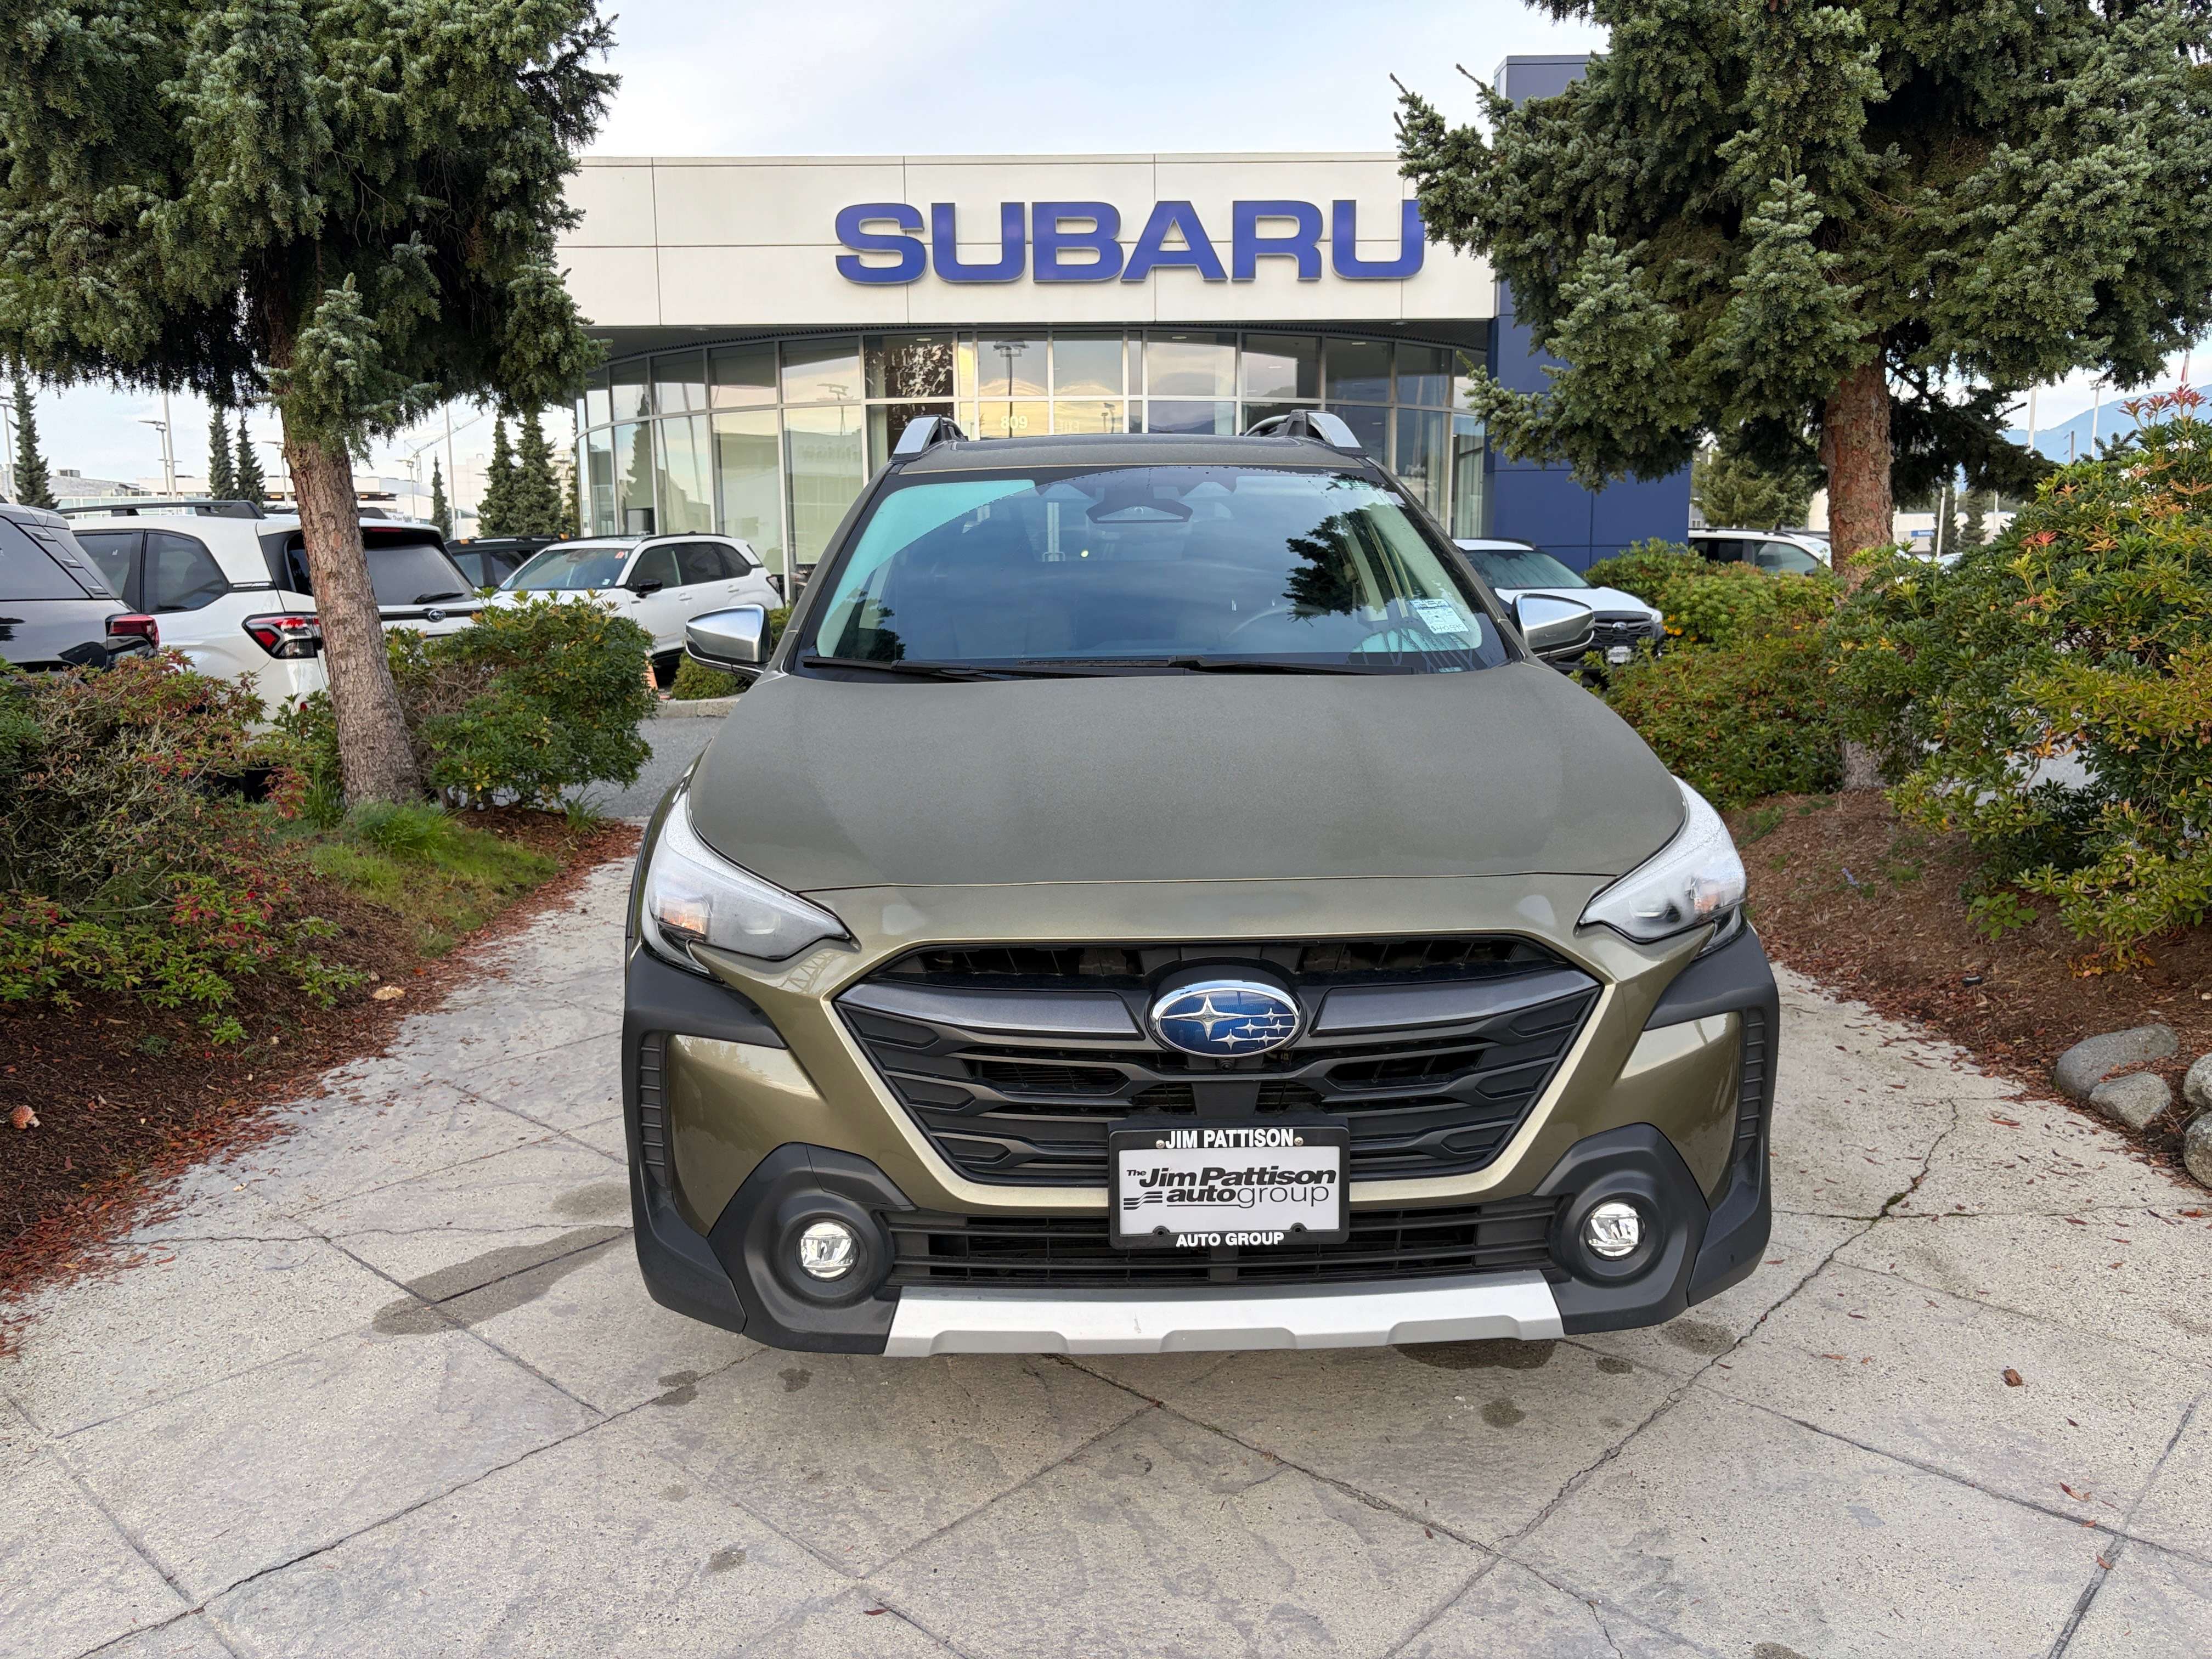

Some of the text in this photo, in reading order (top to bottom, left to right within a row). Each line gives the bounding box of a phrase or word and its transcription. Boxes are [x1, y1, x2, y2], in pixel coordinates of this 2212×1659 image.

[834, 200, 1425, 285] SUBARU
[1000, 415, 1028, 430] 809
[1165, 1128, 1294, 1149] JIM PATTISON
[1126, 1165, 1337, 1188] The Jim Pattison
[1175, 1232, 1285, 1248] AUTO GROUP
